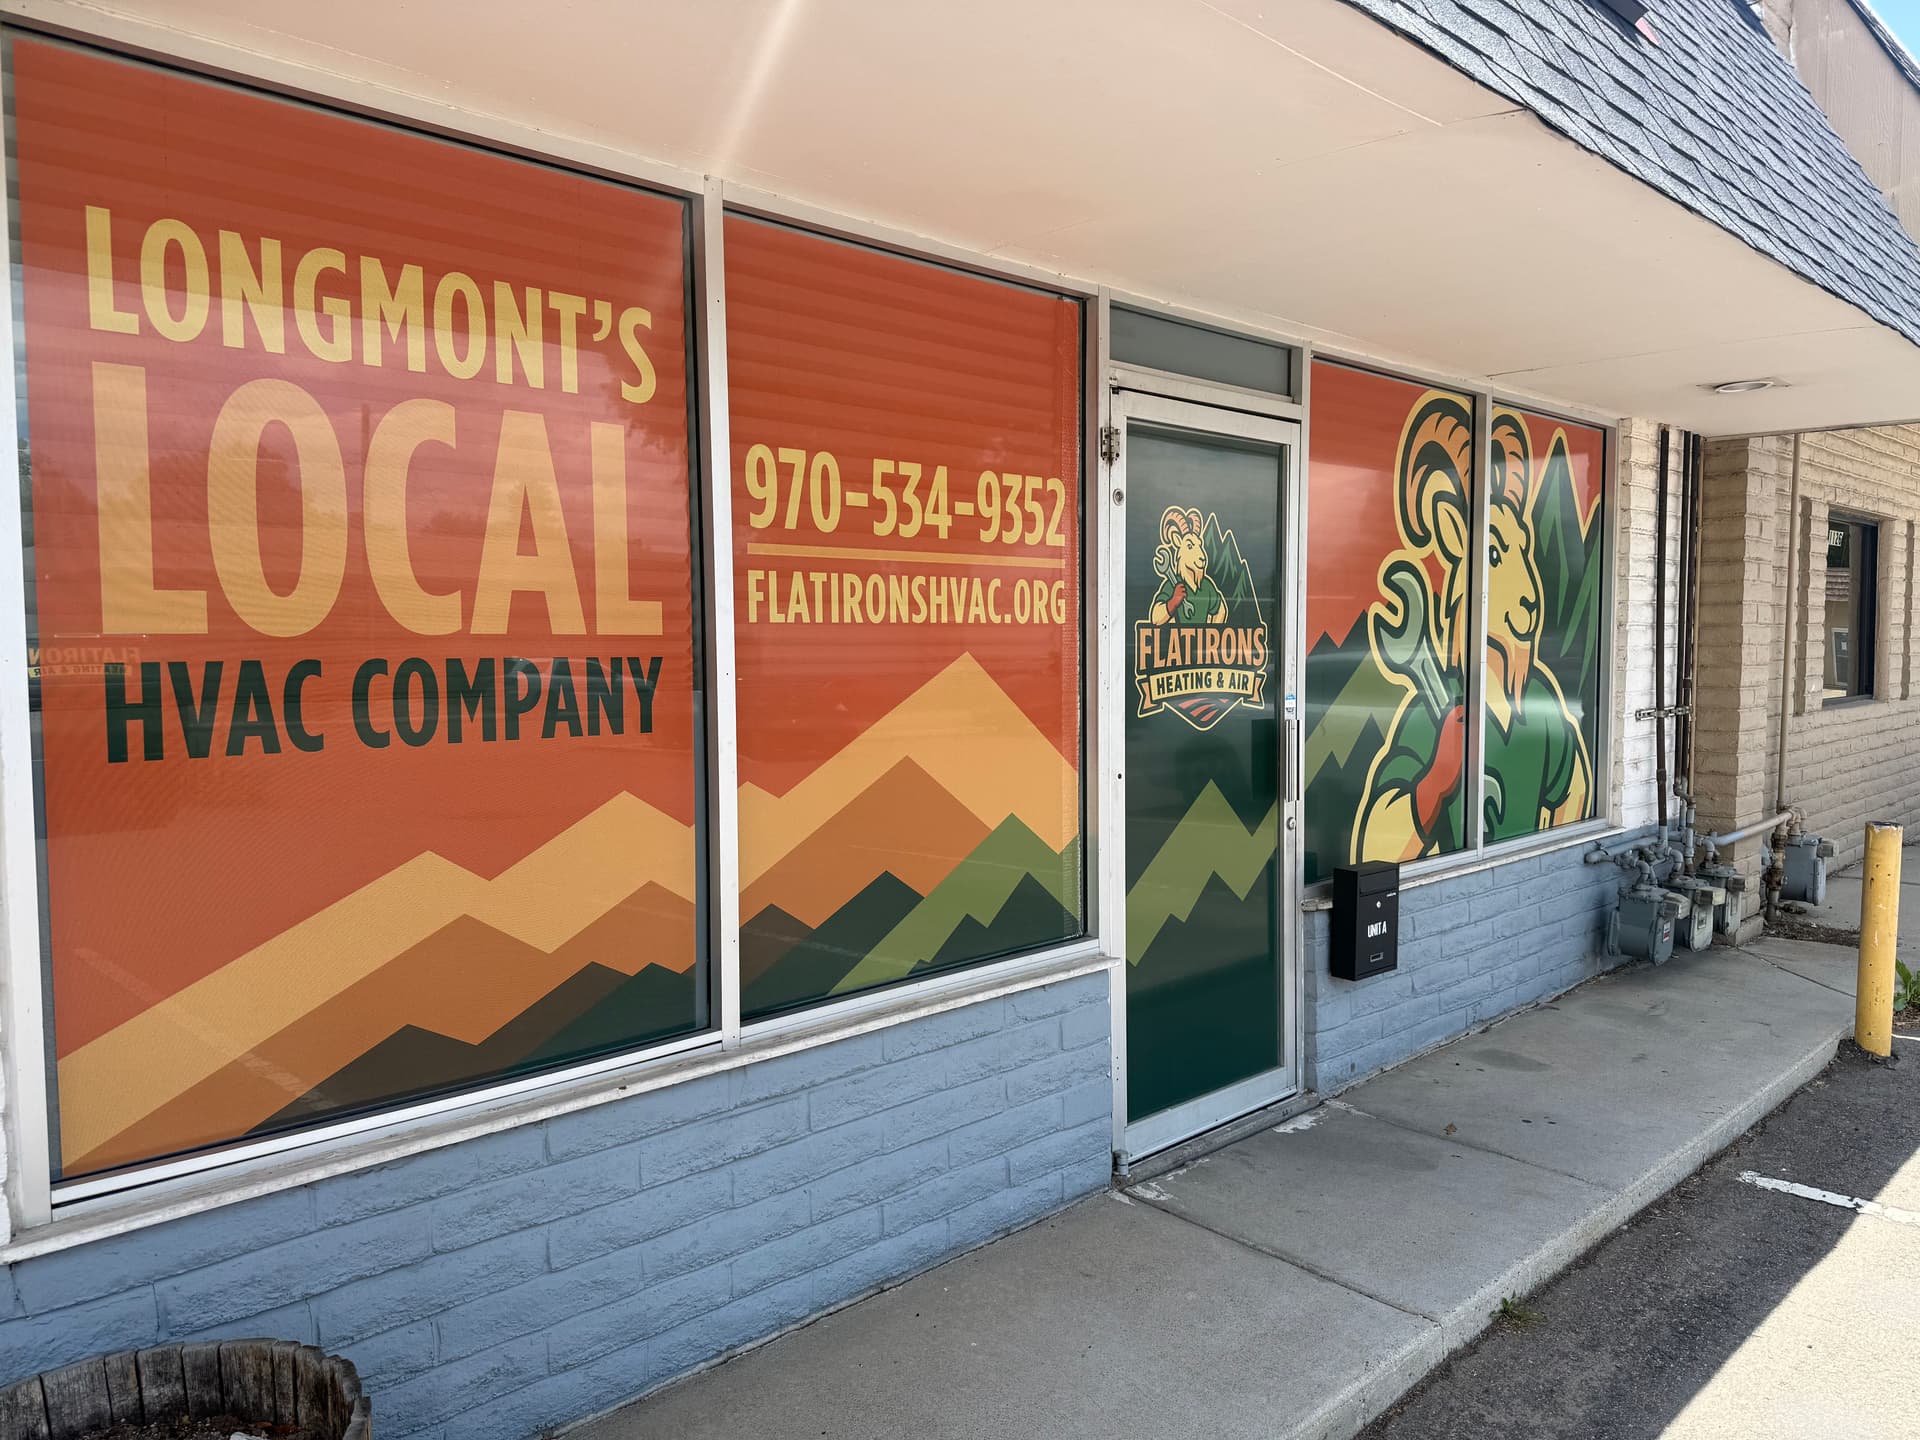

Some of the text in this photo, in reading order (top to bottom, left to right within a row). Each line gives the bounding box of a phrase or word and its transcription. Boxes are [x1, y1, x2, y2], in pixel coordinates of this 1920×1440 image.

[85, 205, 657, 403] LONGMONT'S
[92, 361, 663, 637] LOCAL
[744, 443, 1066, 547] 970-534-9352
[747, 569, 1066, 625] FLATIRONSHVAC.ORG
[1139, 628, 1264, 670] FLATIRONS
[1157, 671, 1249, 695] HEATING & AIR
[106, 656, 664, 763] HVAC COMPANY
[1367, 920, 1387, 938] UNIT A
